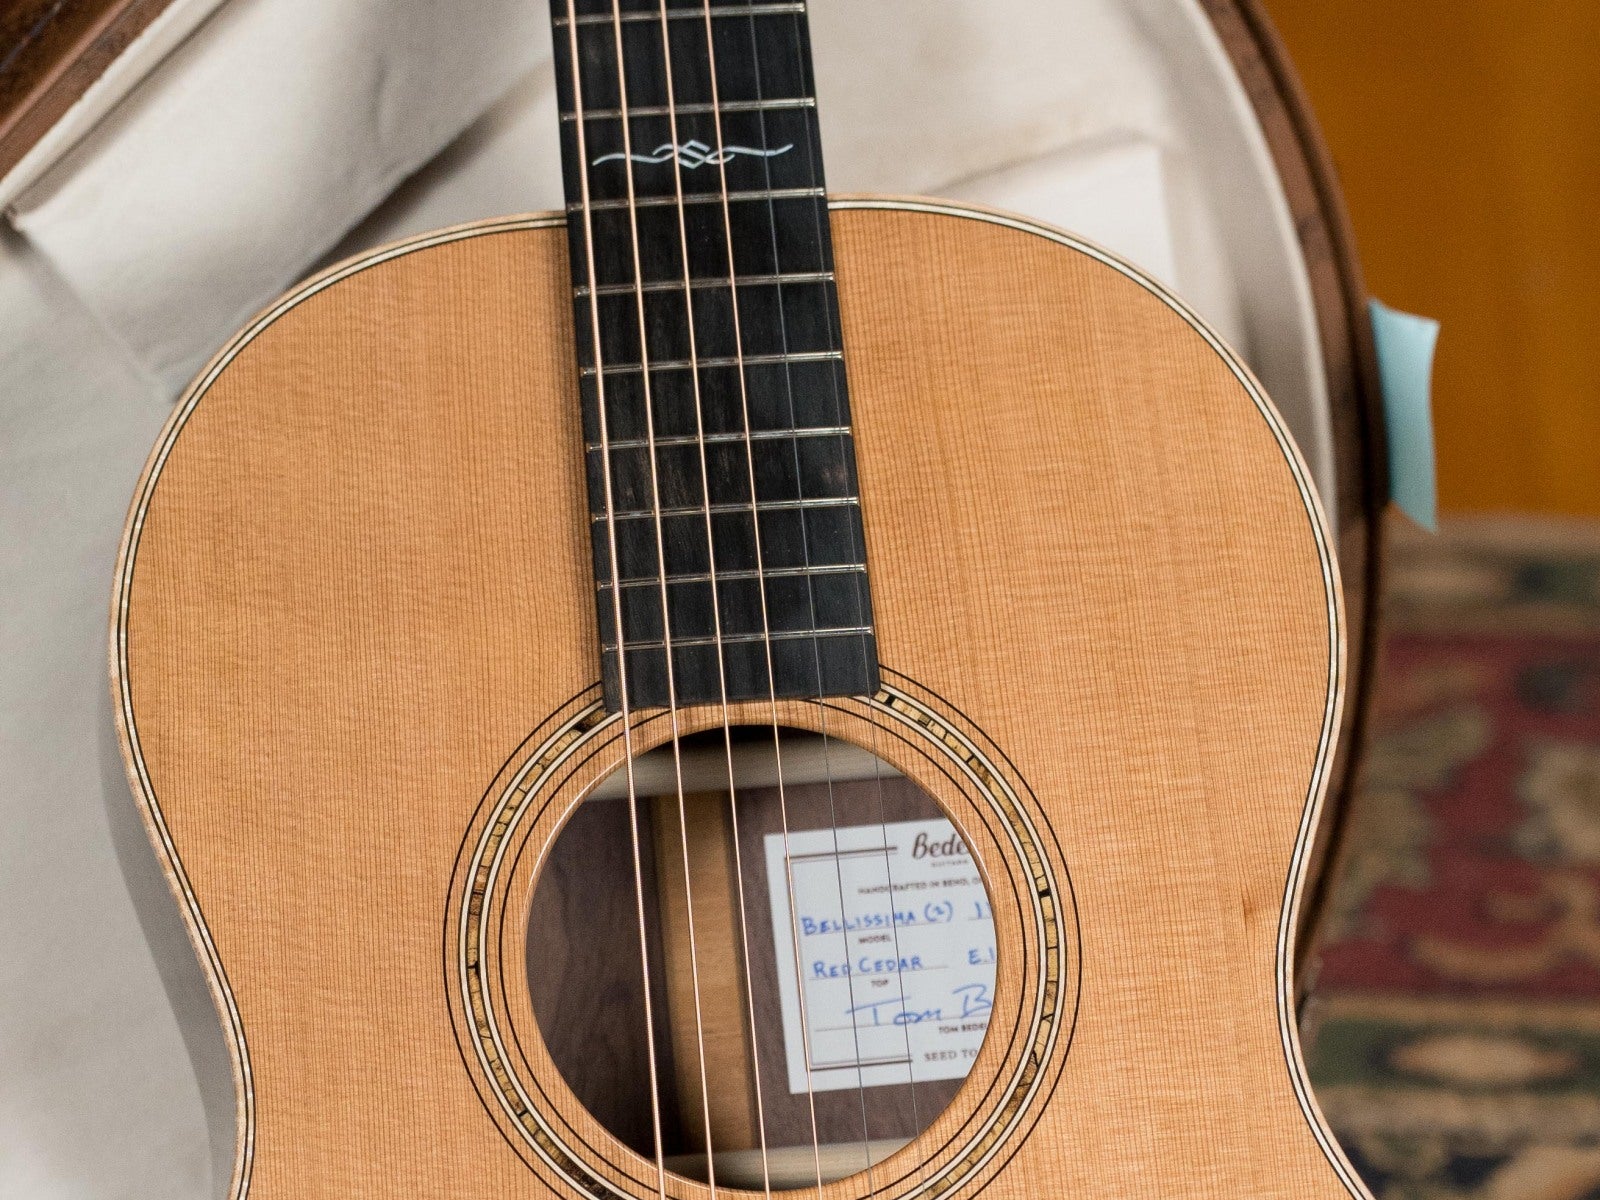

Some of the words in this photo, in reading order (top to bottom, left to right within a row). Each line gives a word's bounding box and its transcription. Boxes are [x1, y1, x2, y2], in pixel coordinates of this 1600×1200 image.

[858, 934, 892, 945] MODEL
[813, 960, 852, 979] RED
[858, 955, 924, 974] CEDAR
[870, 979, 889, 988] TOP
[938, 1026, 959, 1035] TOM
[924, 1050, 958, 1062] SEED
